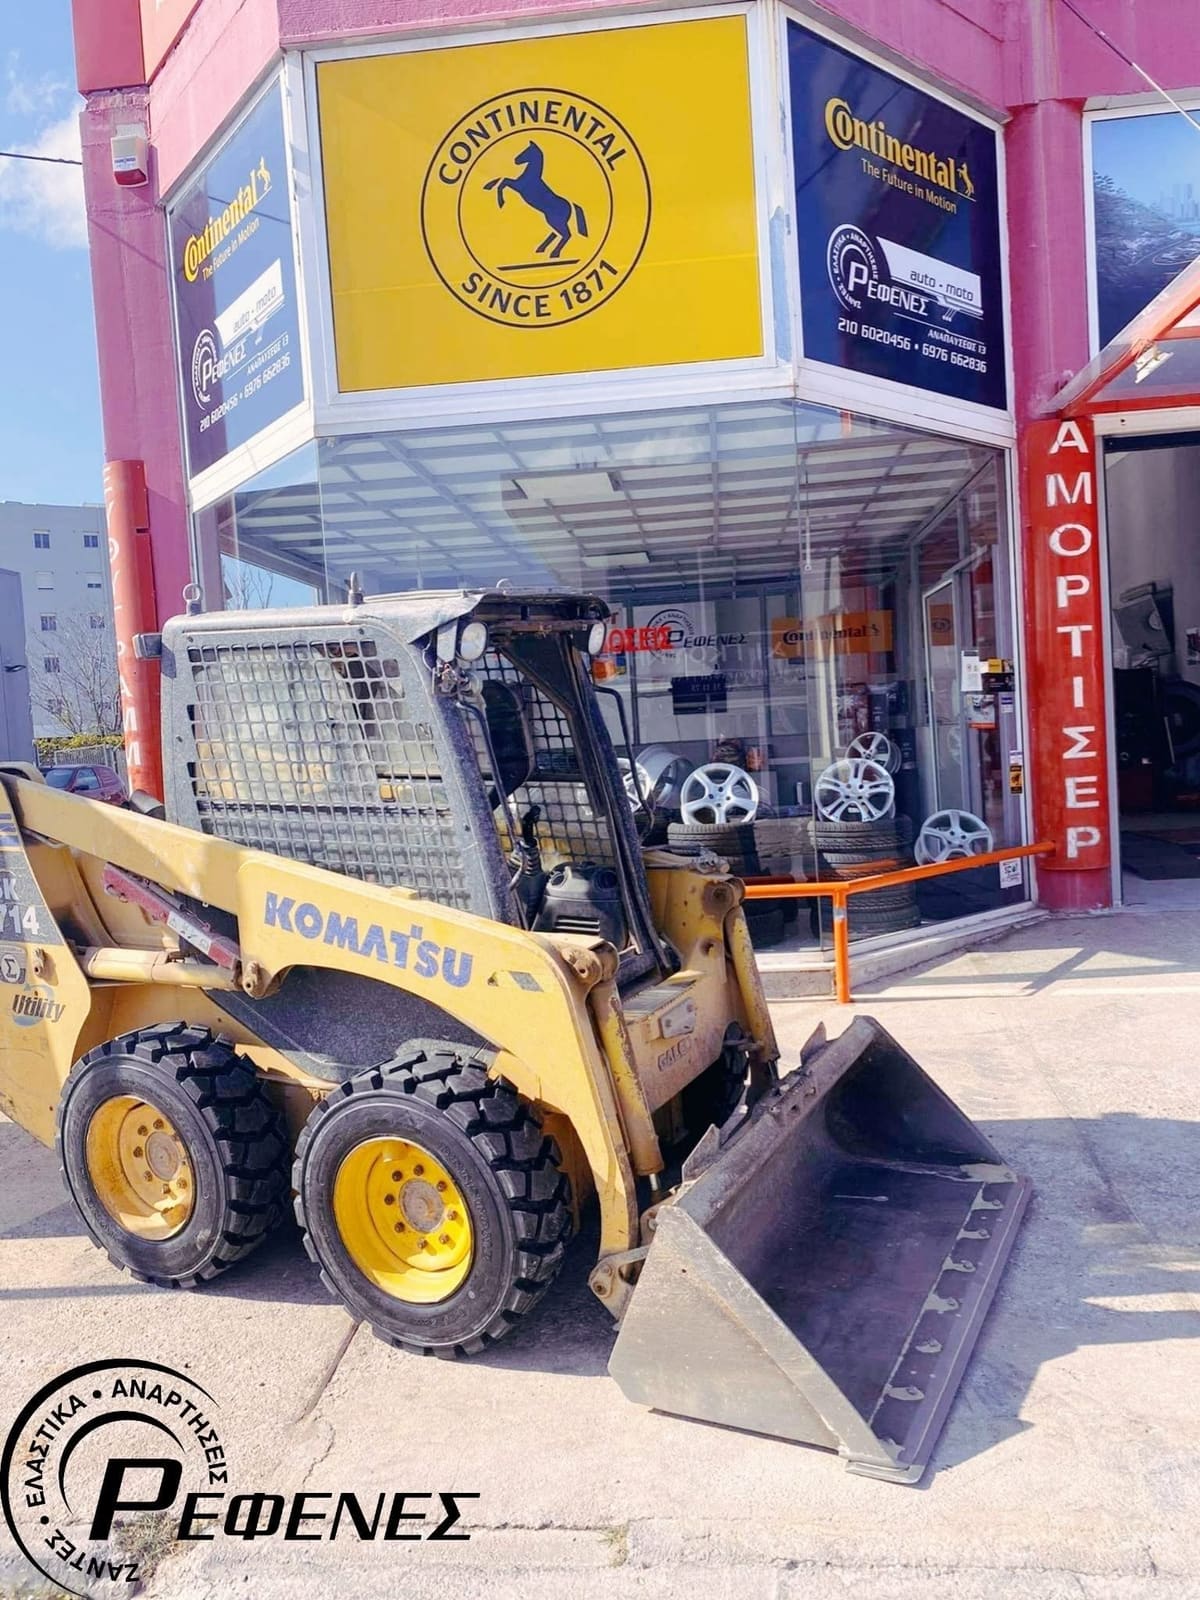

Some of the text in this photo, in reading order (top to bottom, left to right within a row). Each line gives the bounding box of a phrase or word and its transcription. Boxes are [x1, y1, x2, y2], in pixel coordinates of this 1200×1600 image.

[439, 100, 626, 185] CONTINENTAL
[824, 97, 957, 193] Continental
[861, 158, 957, 214] The Future in Motion
[184, 169, 257, 282] Continental
[461, 260, 618, 317] SINCE 1871
[910, 270, 974, 302] auto moto
[837, 317, 987, 373] 210 6020456 6976 662836
[1045, 420, 1101, 859] ΑΜΟΡΤΙΣΕΡ
[264, 891, 473, 988] KOMATSU
[12, 991, 65, 1023] Utility
